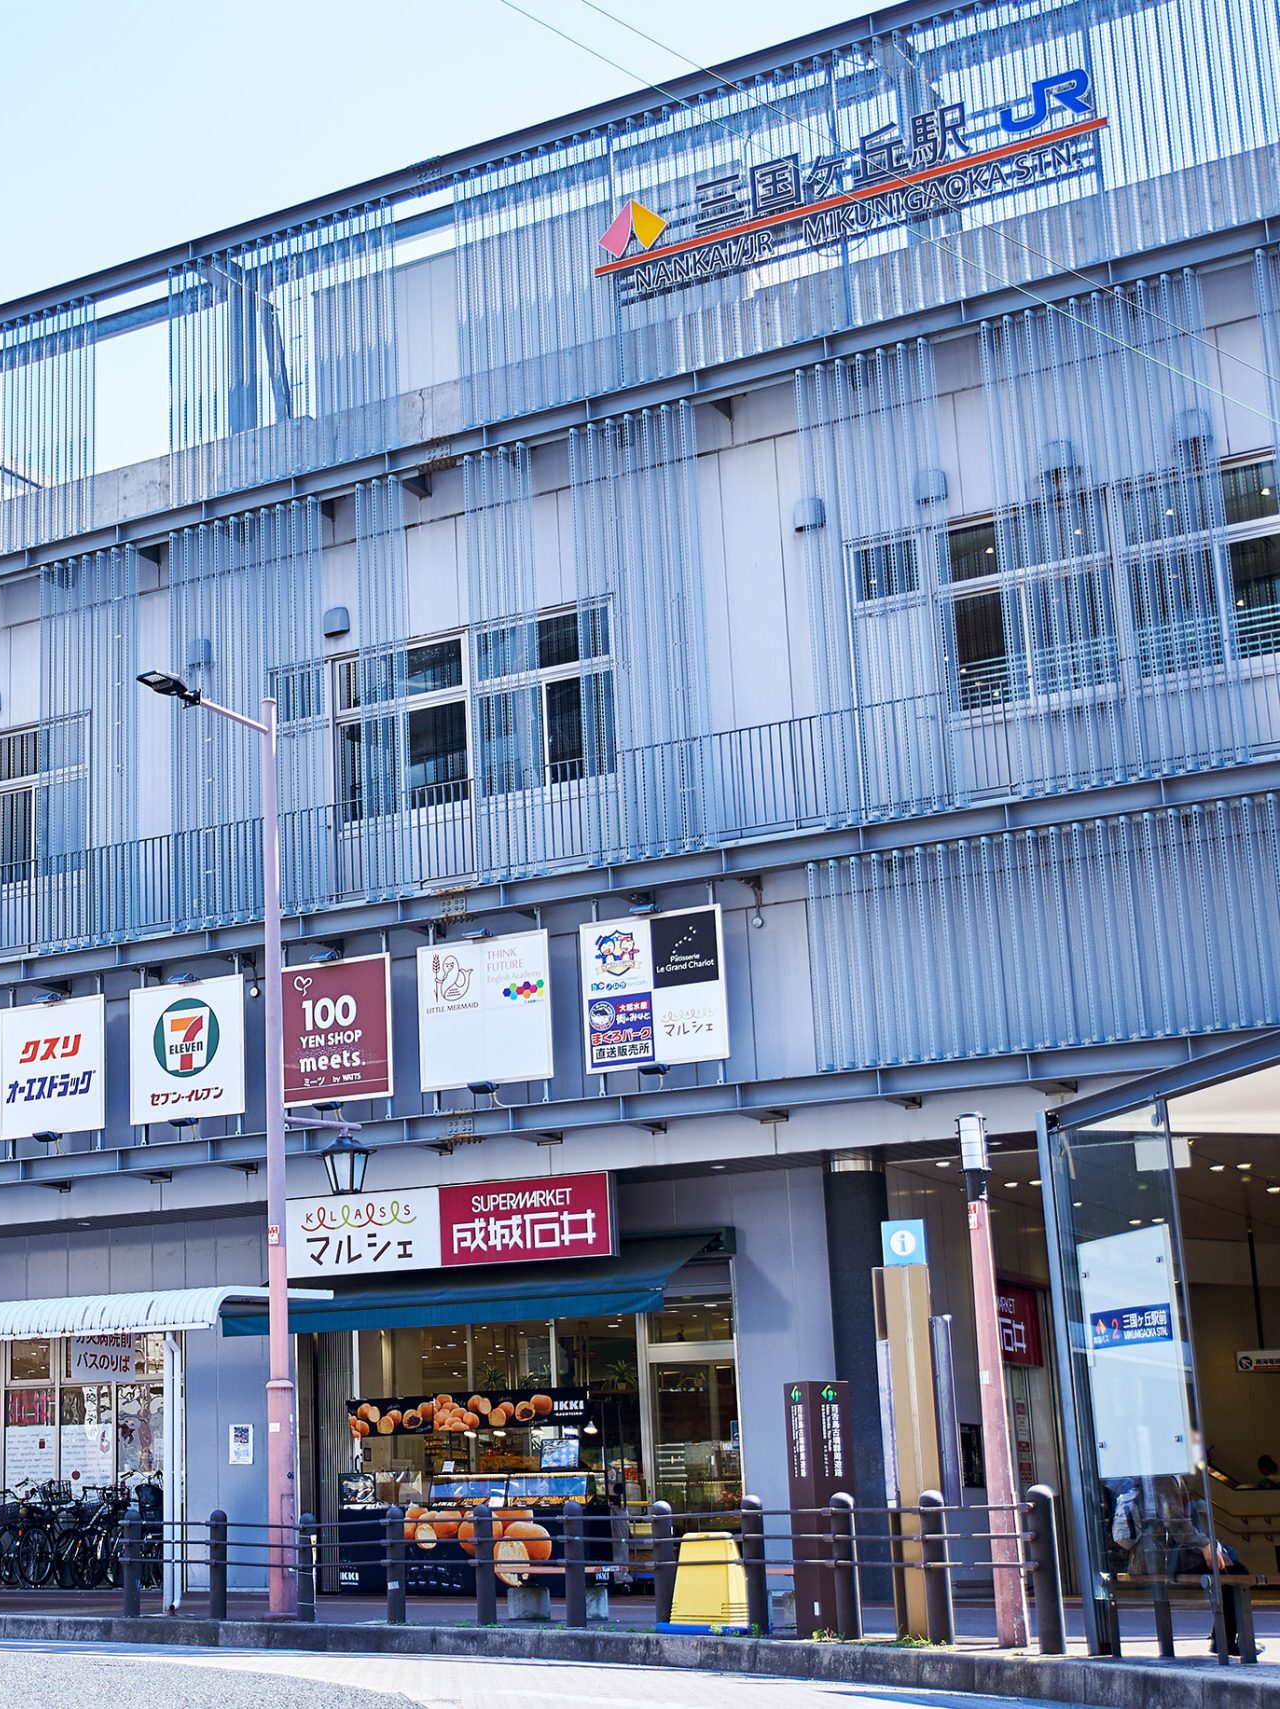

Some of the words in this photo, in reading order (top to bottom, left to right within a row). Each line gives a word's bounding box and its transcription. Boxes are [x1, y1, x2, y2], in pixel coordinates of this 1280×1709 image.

[1000, 68, 1092, 133] JR
[634, 231, 774, 292] NANKAI/JR
[803, 164, 1007, 247] MIKUNIGAOKA
[1015, 141, 1083, 185] STN.
[487, 947, 517, 960] THINK
[487, 958, 523, 973] FUTURE
[656, 964, 665, 973] Le
[666, 961, 687, 972] Grand
[688, 958, 714, 969] Chariot
[487, 973, 511, 984] English
[512, 970, 542, 981] Academy
[302, 994, 357, 1031] 100
[426, 1004, 445, 1015] LITTLE
[447, 1001, 479, 1012] MERMAID
[300, 1034, 325, 1049] YEN
[328, 1029, 362, 1046] SHOP
[664, 1021, 713, 1037] マルシェ
[19, 1033, 81, 1065] クスリ
[596, 1042, 650, 1059] 直送販売所
[299, 1050, 366, 1073] meets.
[6, 1069, 97, 1105] オーエスドラッグ
[304, 1076, 325, 1087] ミーツ
[332, 1074, 341, 1085] by
[472, 1188, 572, 1213] SUPERMARKET
[452, 1209, 596, 1254] 成城石井
[306, 1233, 413, 1266] マルシェ
[999, 1317, 1026, 1354] 石井
[1111, 1318, 1120, 1339] 2
[76, 1351, 130, 1372] バスのりば
[554, 1400, 584, 1411] IKKI
